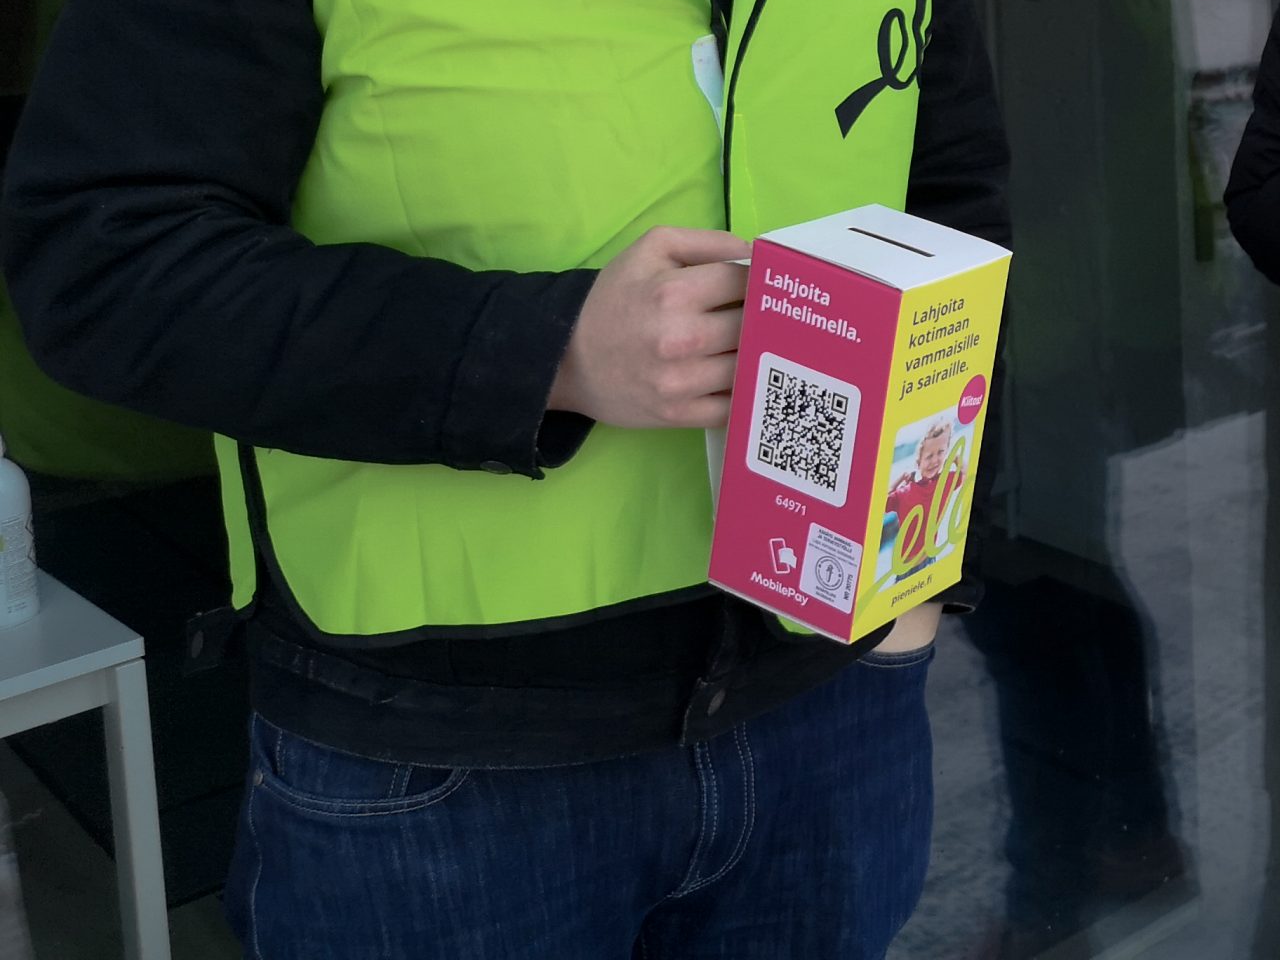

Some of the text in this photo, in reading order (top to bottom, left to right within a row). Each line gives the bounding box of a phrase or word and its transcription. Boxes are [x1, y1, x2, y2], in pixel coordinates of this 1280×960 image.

[764, 268, 831, 306] Lahjoita
[761, 294, 862, 343] puhelimella.
[912, 298, 965, 326] Lahjoita
[908, 318, 970, 349] kotimaan
[905, 334, 980, 372] vammaisille
[899, 359, 969, 401] ja sairaille.
[775, 494, 807, 516] 64971
[750, 571, 809, 606] MobilePay
[891, 573, 933, 607] pieniele.fi
